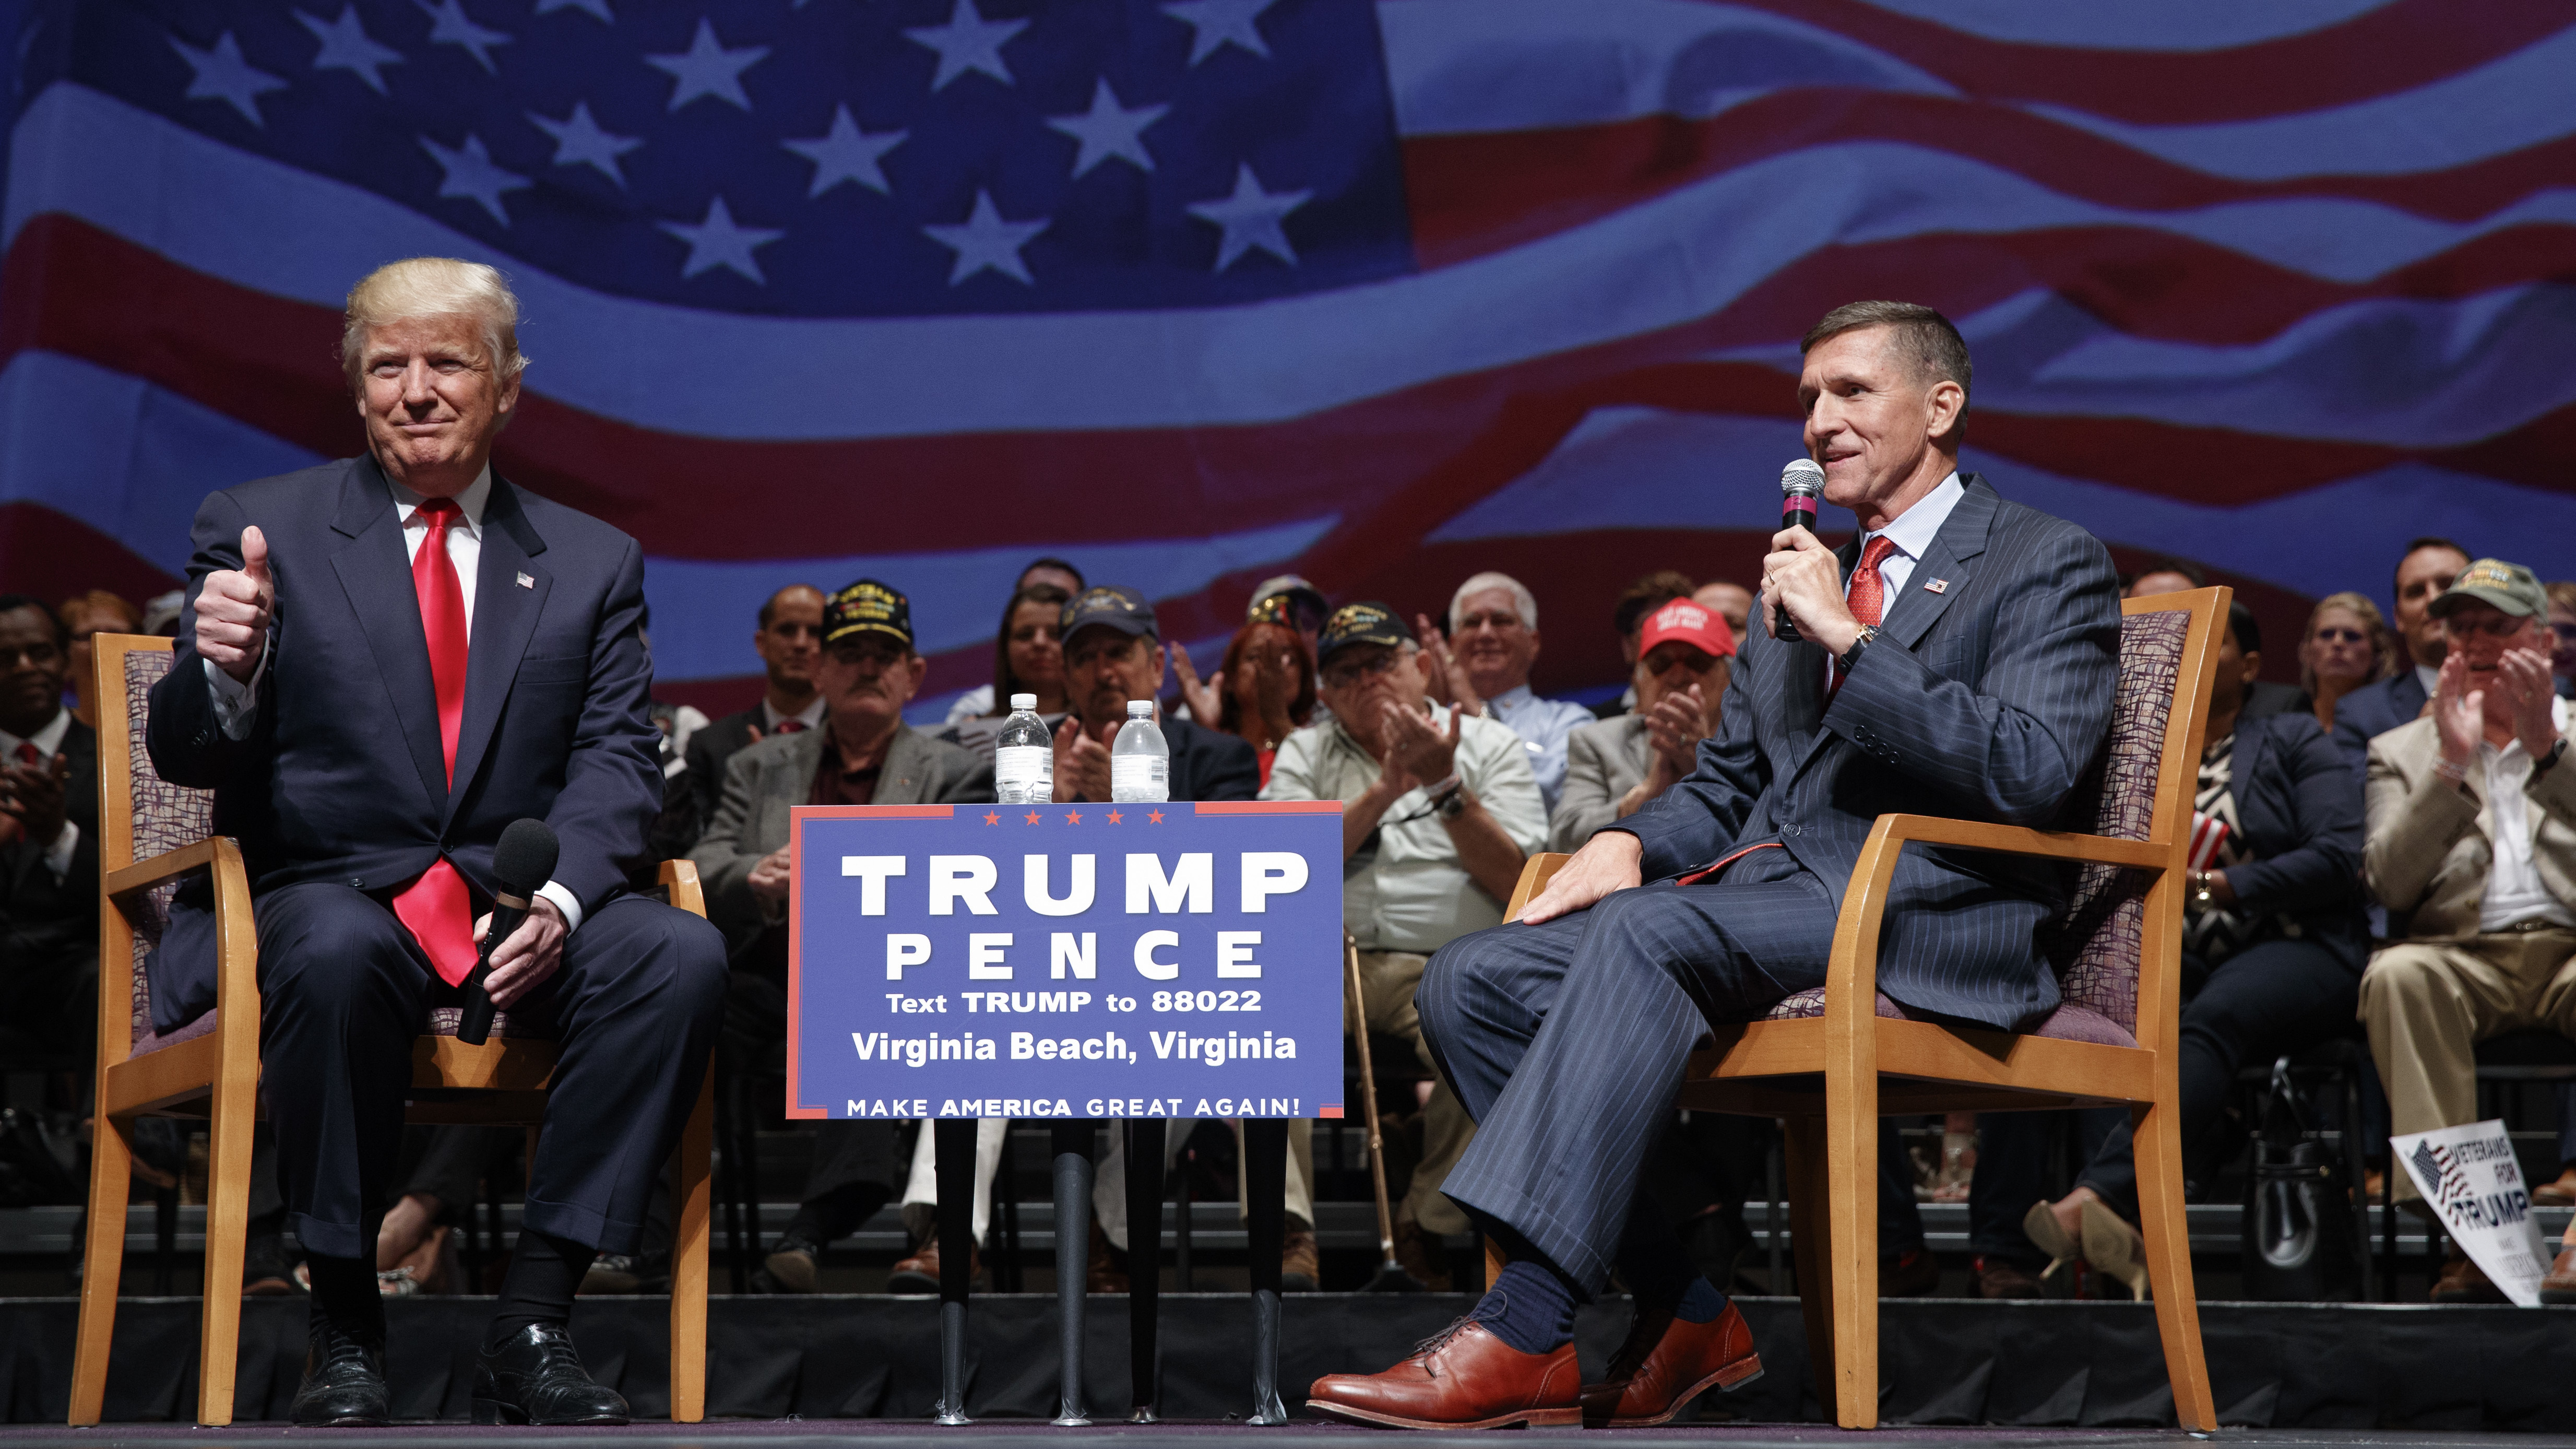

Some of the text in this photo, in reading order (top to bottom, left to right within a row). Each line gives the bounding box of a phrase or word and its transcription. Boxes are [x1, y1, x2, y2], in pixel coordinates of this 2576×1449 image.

[841, 852, 1309, 917] TRUMP
[886, 929, 1262, 981] PENCE
[885, 990, 1262, 1014] Text TRUMP to 88022
[851, 1030, 1297, 1068] Virginia Beach, Virginia
[847, 1098, 1299, 1116] MAKE AMERICA GREAT AGAIN!
[2450, 1136, 2509, 1165] VETERANS
[2494, 1162, 2518, 1185] FOR
[2451, 1189, 2527, 1230] TRUMP
